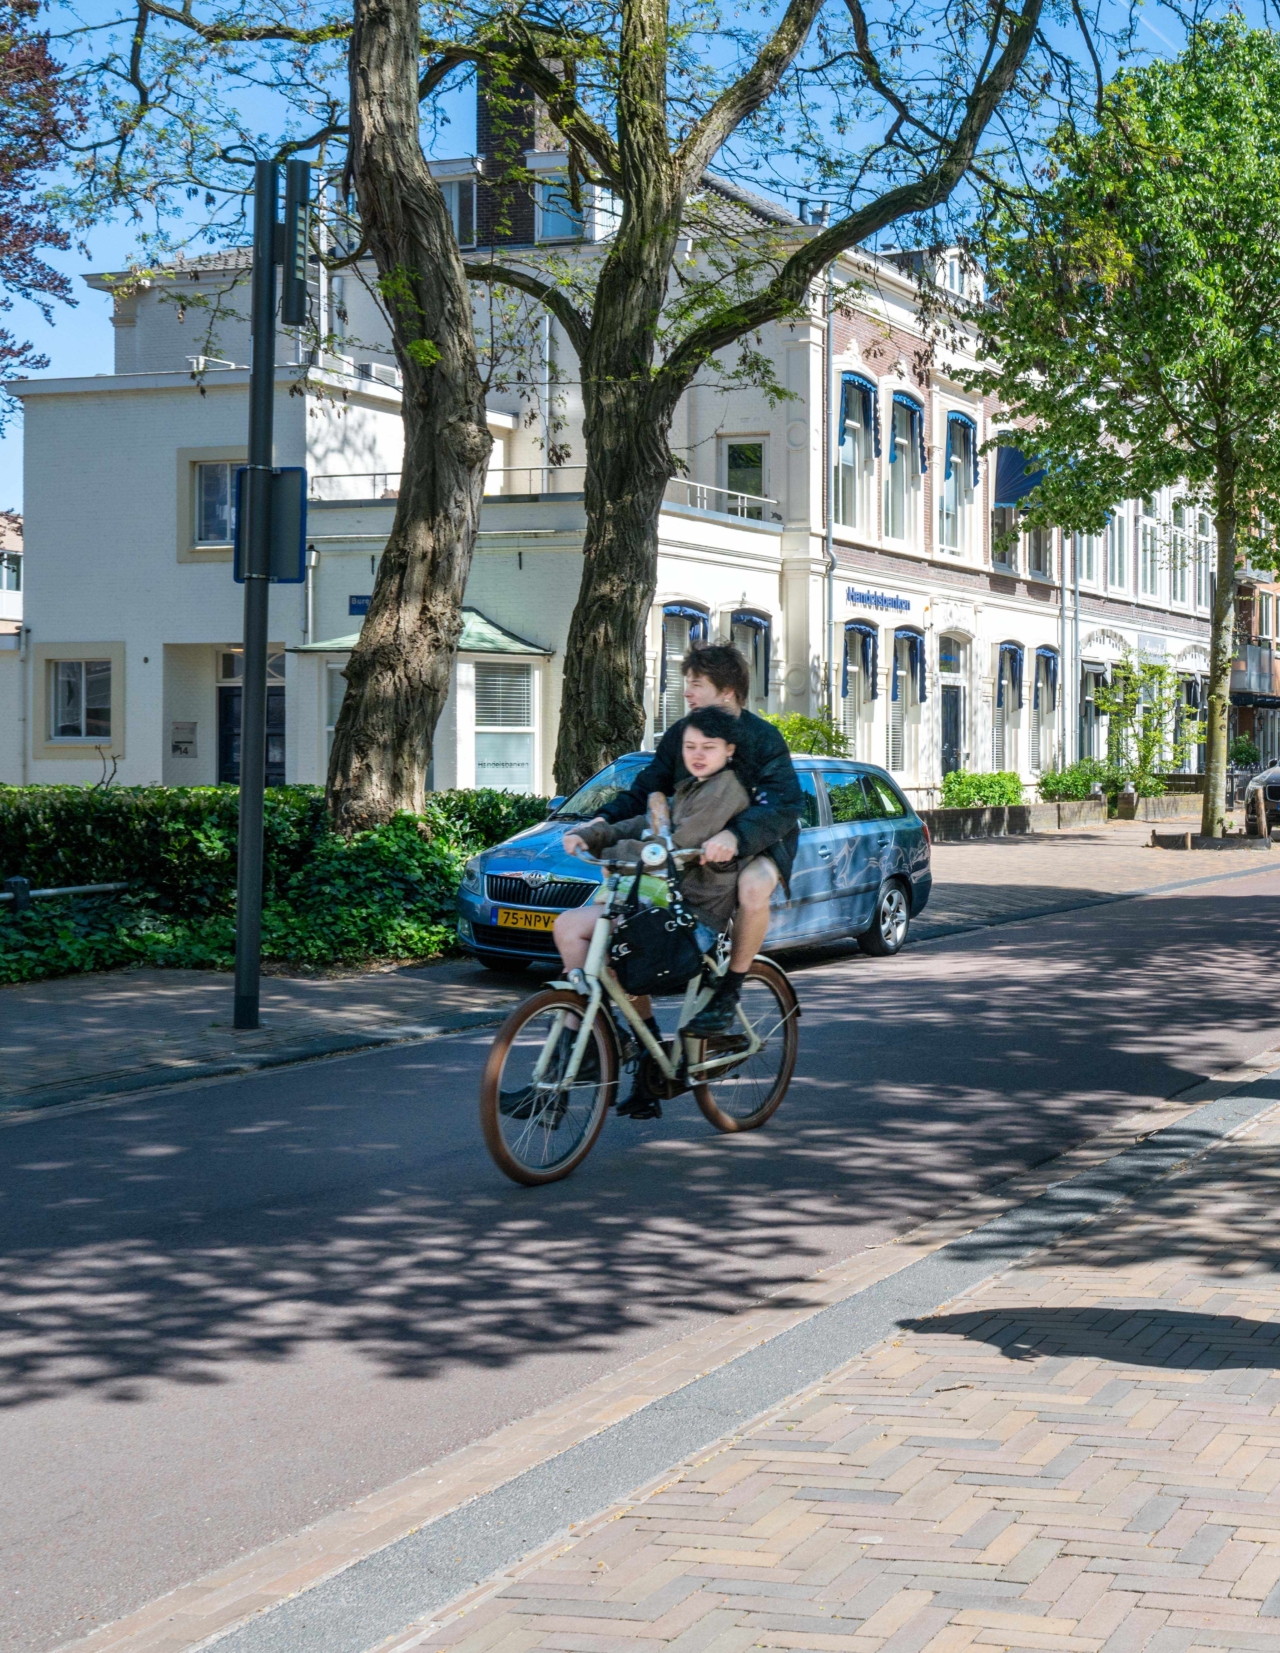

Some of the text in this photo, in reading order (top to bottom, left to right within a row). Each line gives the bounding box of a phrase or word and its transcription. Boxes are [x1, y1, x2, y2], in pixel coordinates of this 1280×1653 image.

[846, 586, 911, 611] Handelsbanken
[179, 746, 189, 755] 14
[477, 760, 529, 769] Handelsbanken
[503, 911, 555, 928] 75-NPV-
